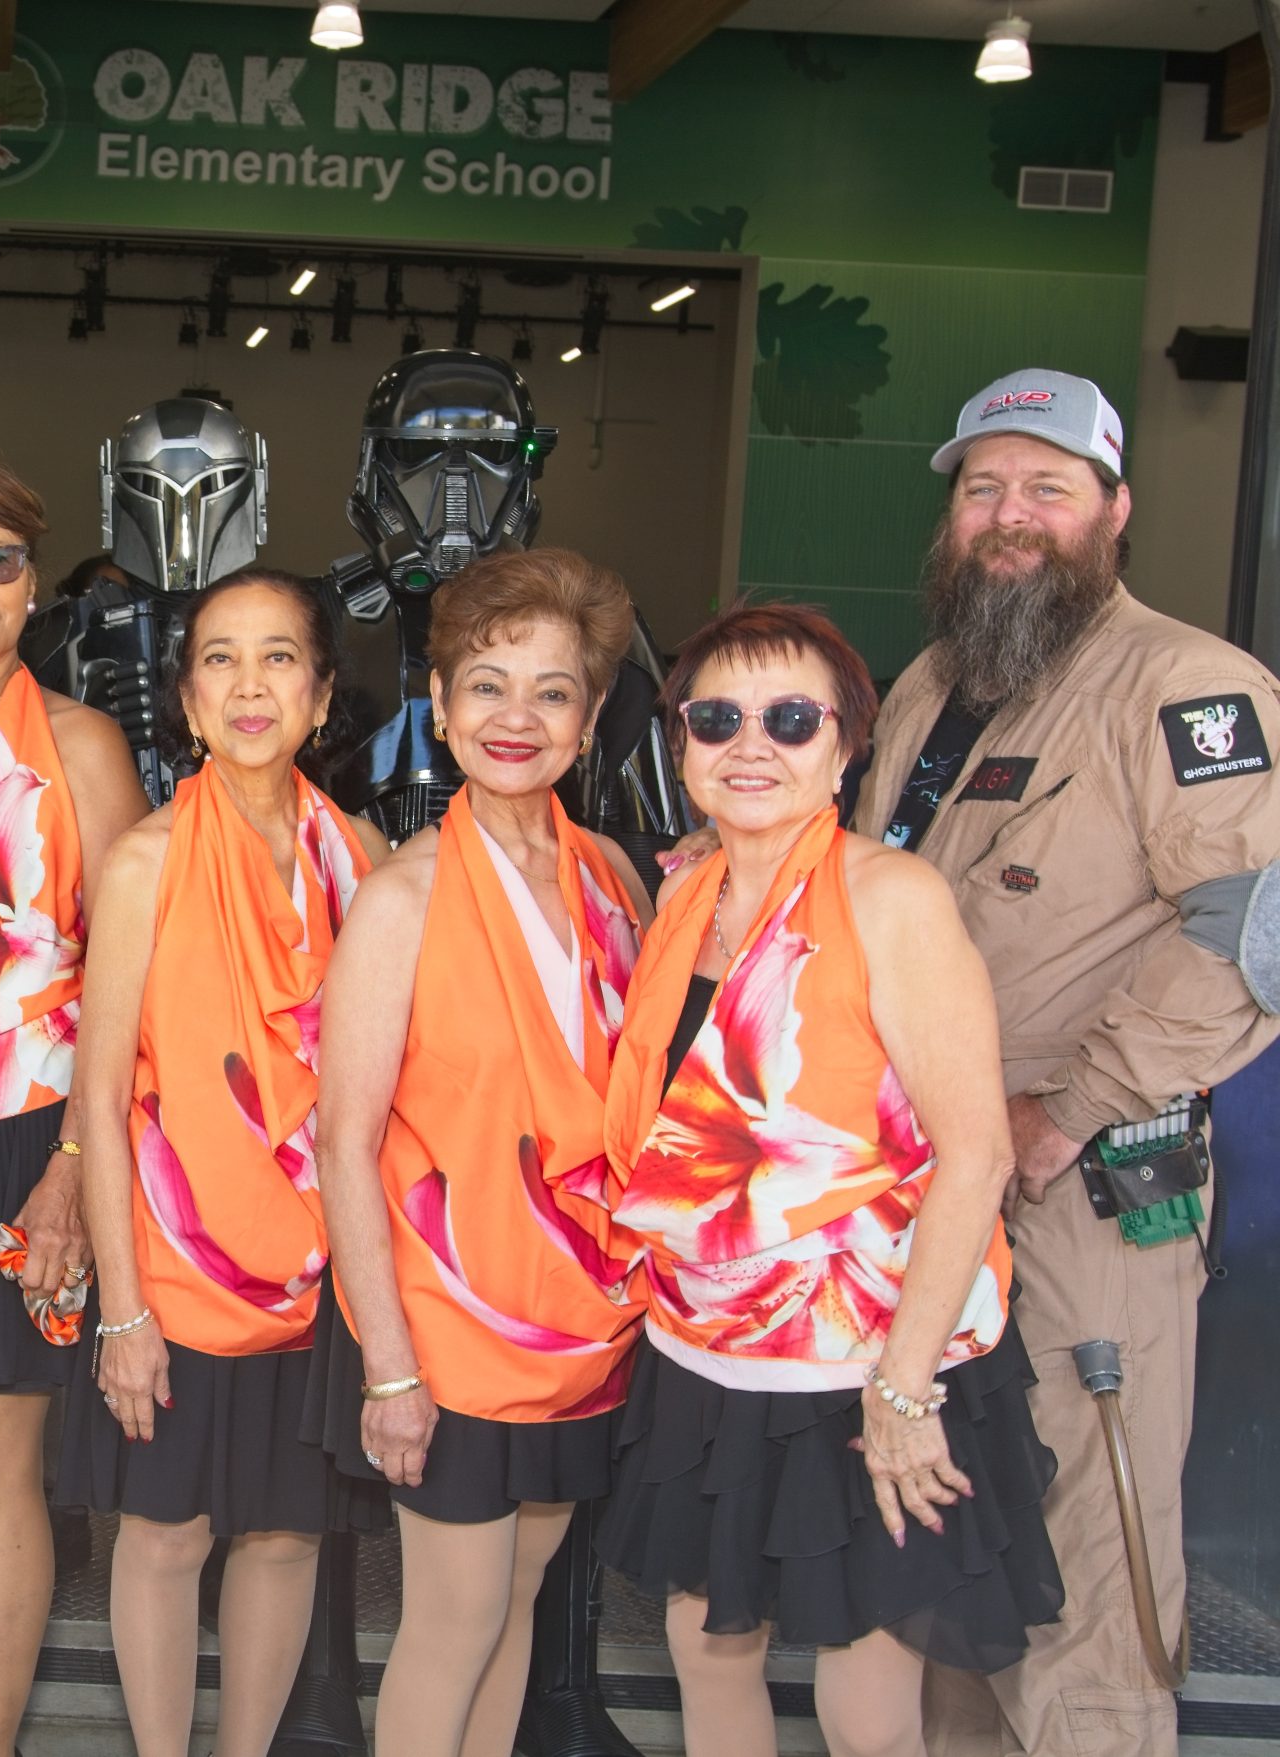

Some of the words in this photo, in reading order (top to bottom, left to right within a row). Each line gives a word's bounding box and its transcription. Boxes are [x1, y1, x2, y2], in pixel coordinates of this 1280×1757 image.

[93, 48, 308, 126] OAK
[334, 60, 612, 141] RIDGE
[97, 132, 405, 201] Elementary
[422, 148, 611, 200] School
[1183, 757, 1263, 779] GHOSTBUSTERS
